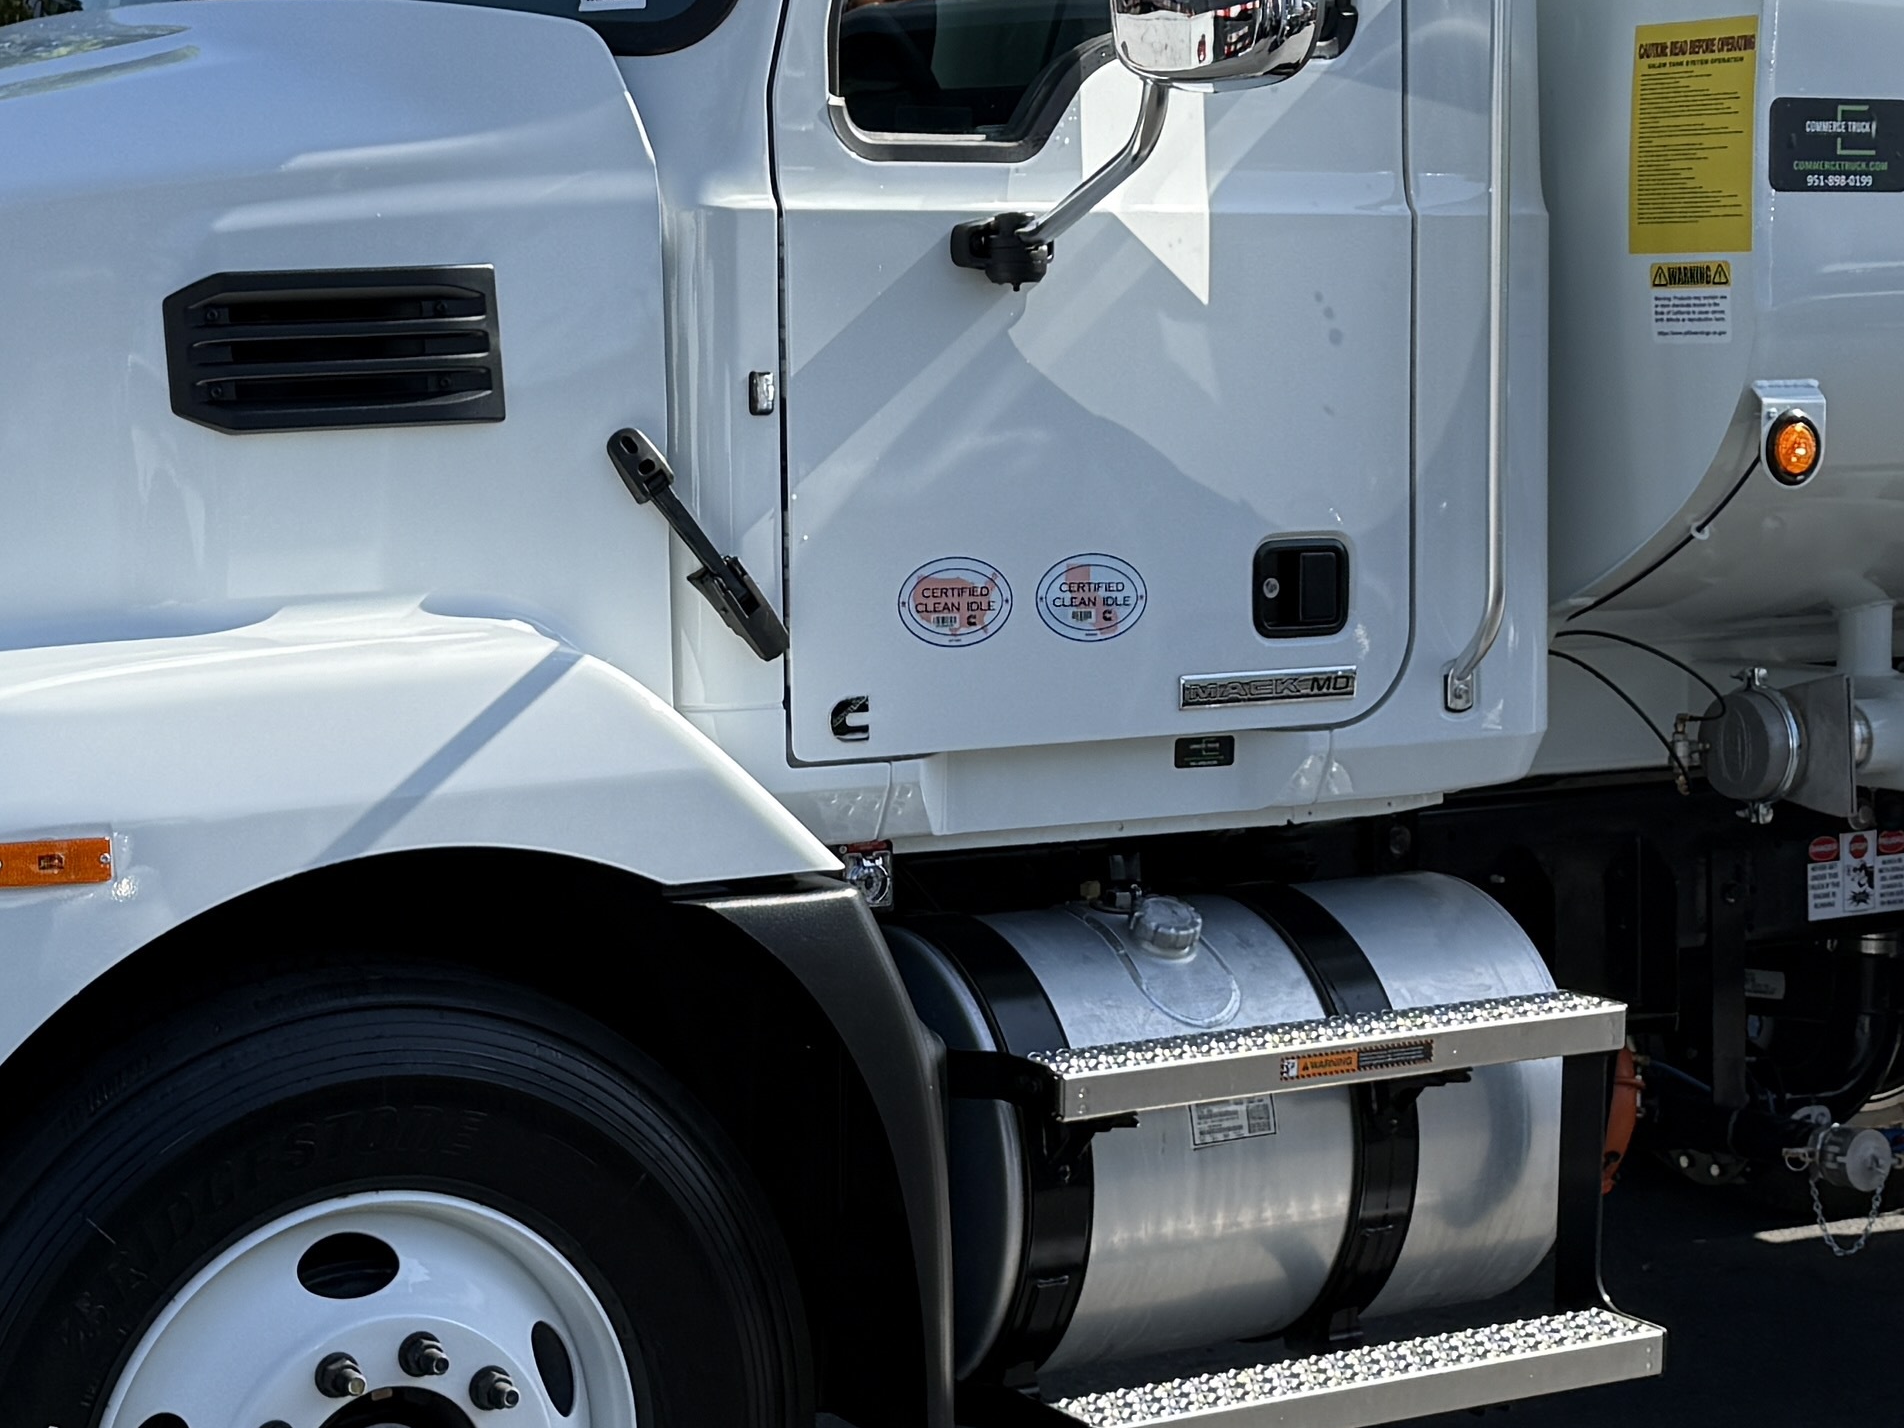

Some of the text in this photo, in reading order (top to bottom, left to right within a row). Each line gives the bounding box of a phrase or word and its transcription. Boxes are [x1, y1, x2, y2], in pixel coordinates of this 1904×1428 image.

[1806, 121, 1871, 133] COMMERCE TRUCK
[1806, 175, 1873, 186] 951-898-0199
[1668, 265, 1712, 285] WARNING
[921, 586, 990, 599] CERTIFIED
[1059, 582, 1125, 594] CERTIFIED
[915, 600, 996, 614] CLEAN IDLE
[1052, 595, 1131, 608] CLEAN IDLE
[1188, 674, 1352, 701] MACK MD
[1309, 1056, 1353, 1070] WARNING
